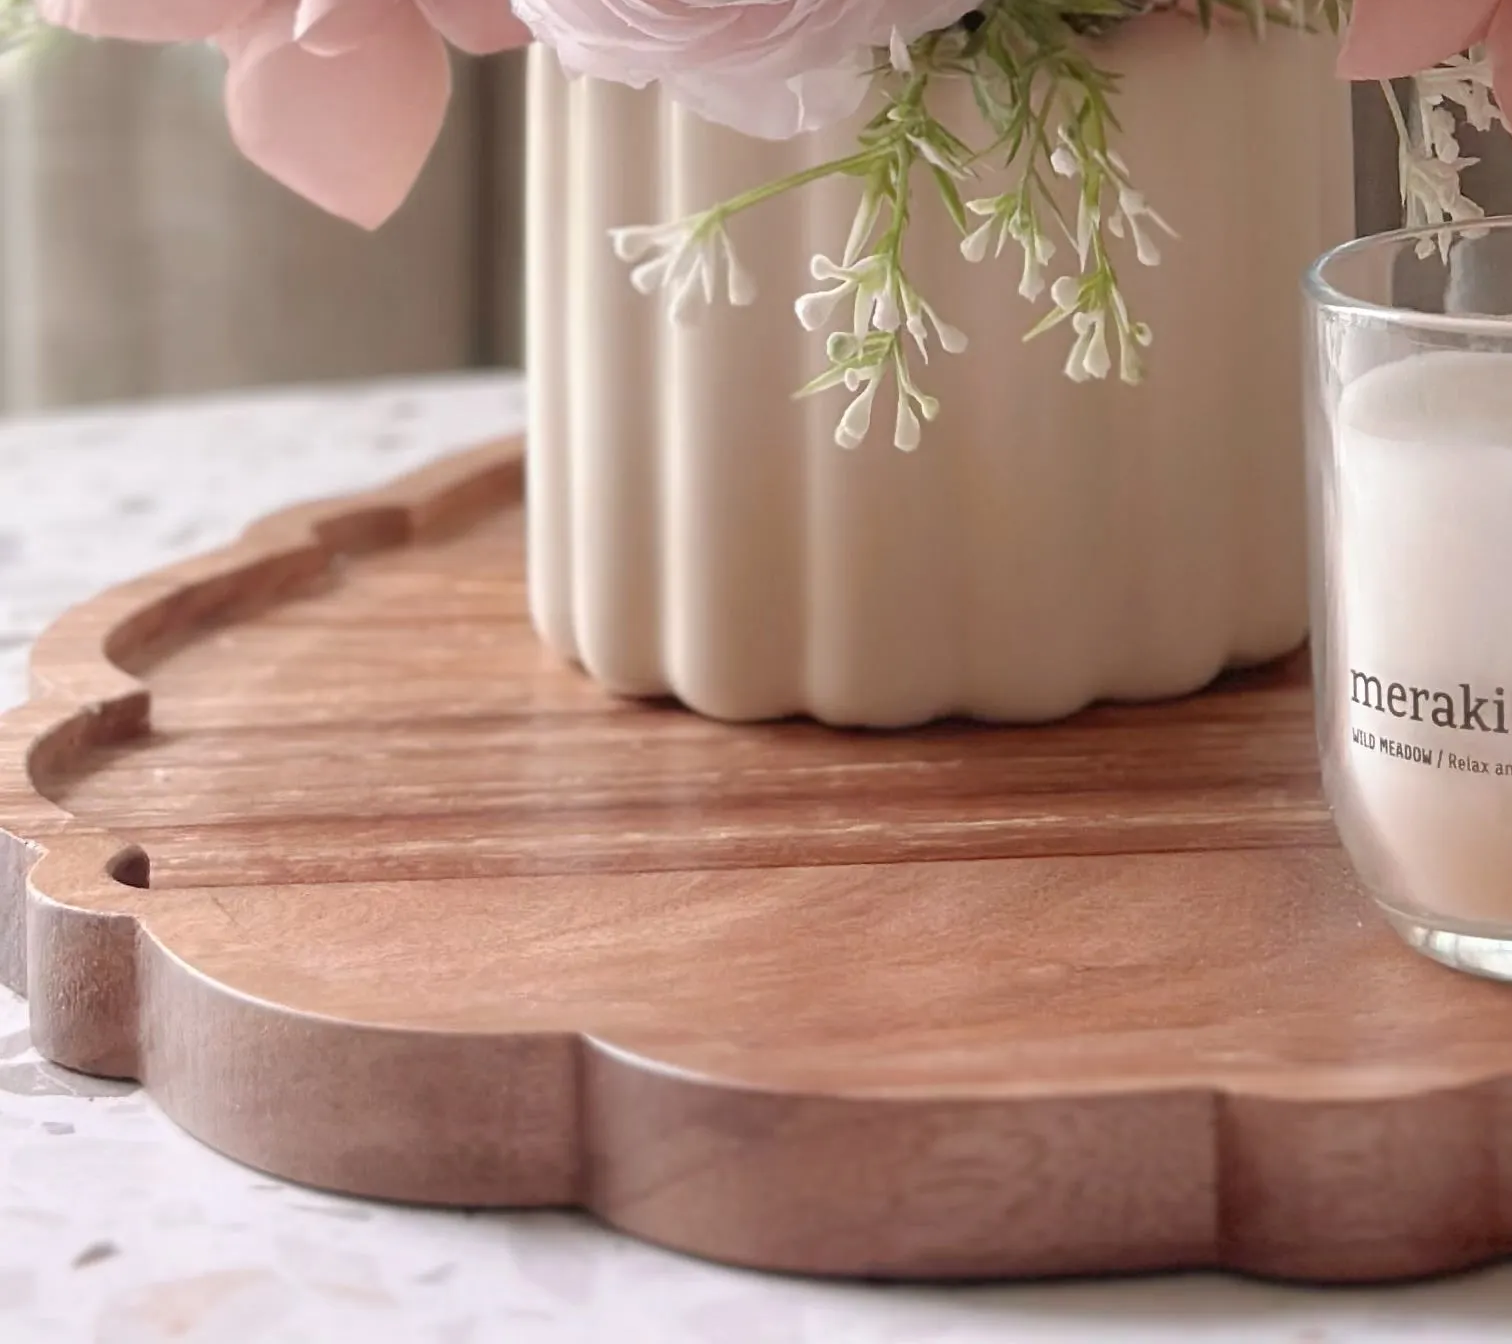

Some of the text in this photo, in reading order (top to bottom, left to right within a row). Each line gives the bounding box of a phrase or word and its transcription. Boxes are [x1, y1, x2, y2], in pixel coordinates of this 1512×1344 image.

[1350, 669, 1509, 734] meraki
[1352, 727, 1376, 750] WILD
[1379, 736, 1433, 765] MEADOW
[1437, 749, 1444, 769] /
[1448, 752, 1490, 774] Relax
